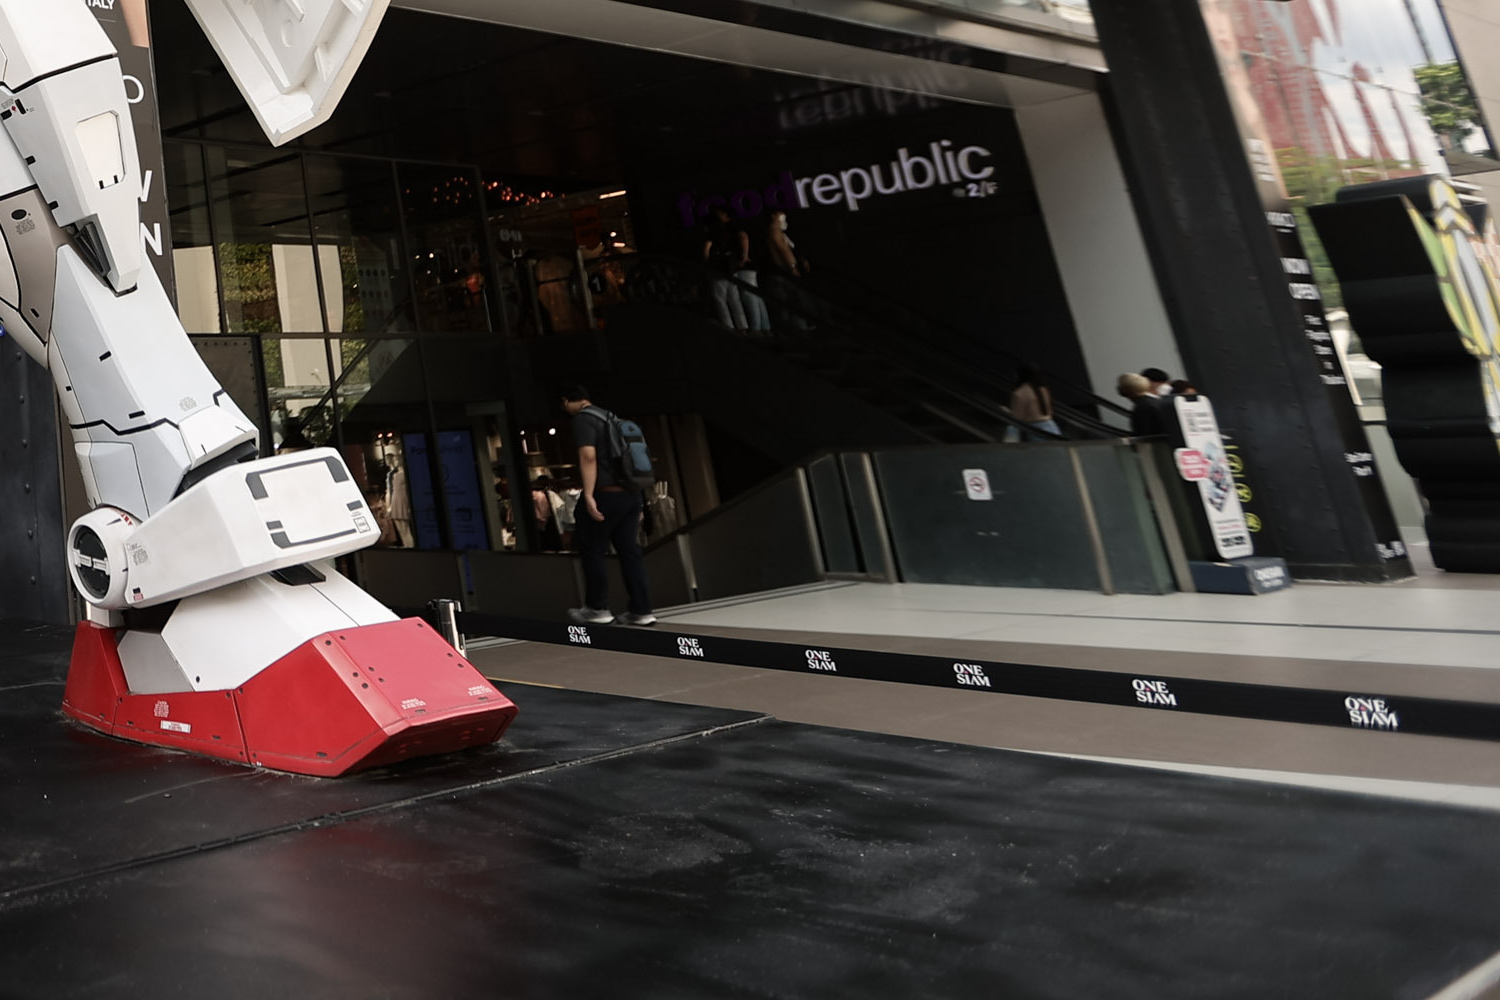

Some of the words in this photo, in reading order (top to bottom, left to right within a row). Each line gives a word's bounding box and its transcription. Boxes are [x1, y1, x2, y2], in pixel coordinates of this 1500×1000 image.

[567, 625, 587, 637] ONE
[569, 633, 591, 645] SIAM
[677, 636, 700, 649] ONE
[678, 644, 704, 657] SIAM
[805, 649, 831, 662] ONE
[808, 659, 837, 672] SIAM
[953, 662, 984, 677] ONE
[956, 673, 991, 688] SIAM
[1132, 678, 1169, 694] ONE
[1136, 690, 1177, 706] SIAM
[1344, 696, 1388, 713] ONE
[1349, 709, 1398, 728] SIAM
